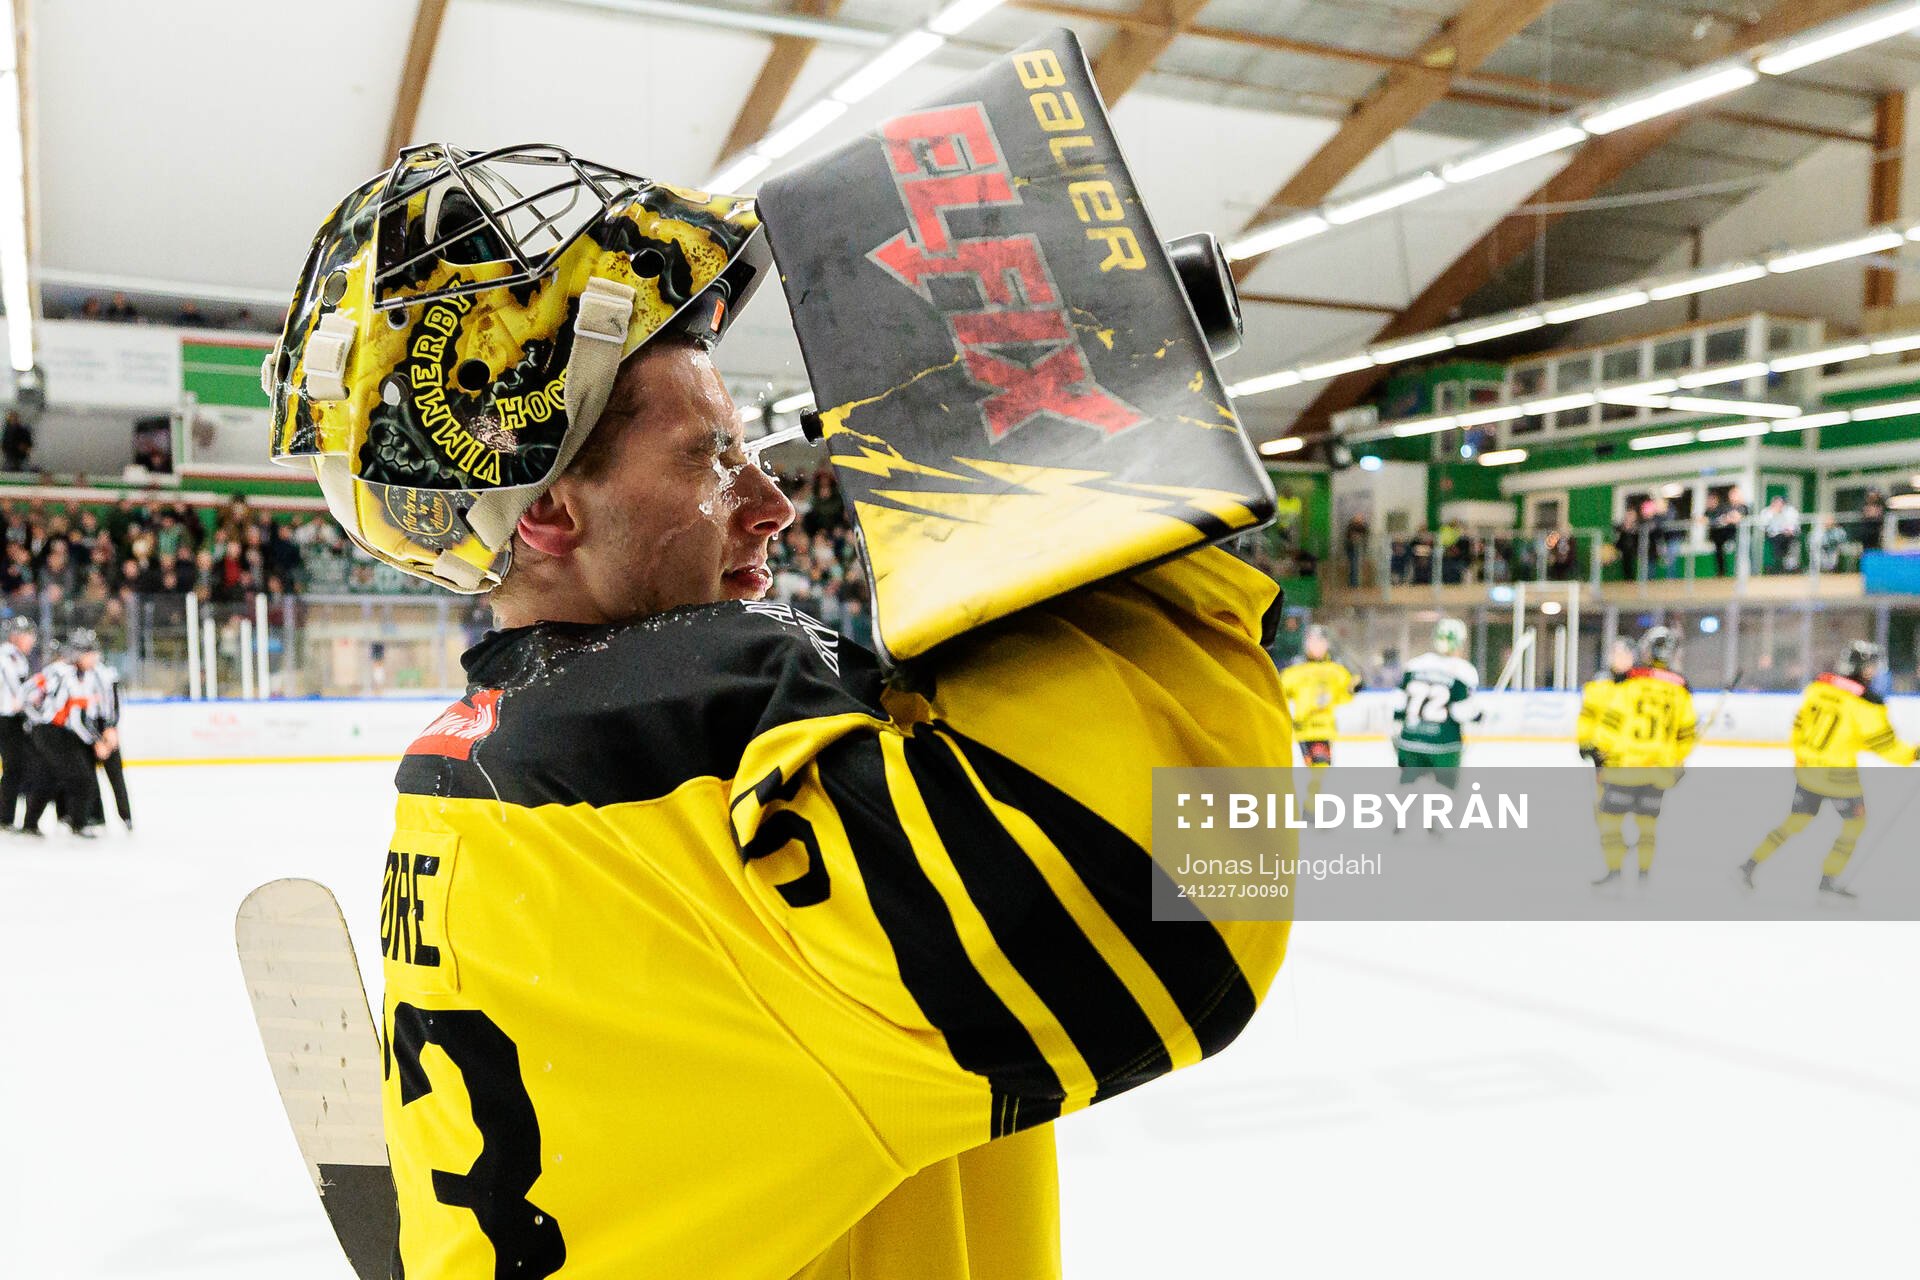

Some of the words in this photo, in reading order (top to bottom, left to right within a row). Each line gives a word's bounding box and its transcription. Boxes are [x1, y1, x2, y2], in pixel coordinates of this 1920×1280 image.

[495, 368, 568, 431] HOC
[866, 101, 1154, 445] ELFIX
[382, 993, 567, 1280] 3
